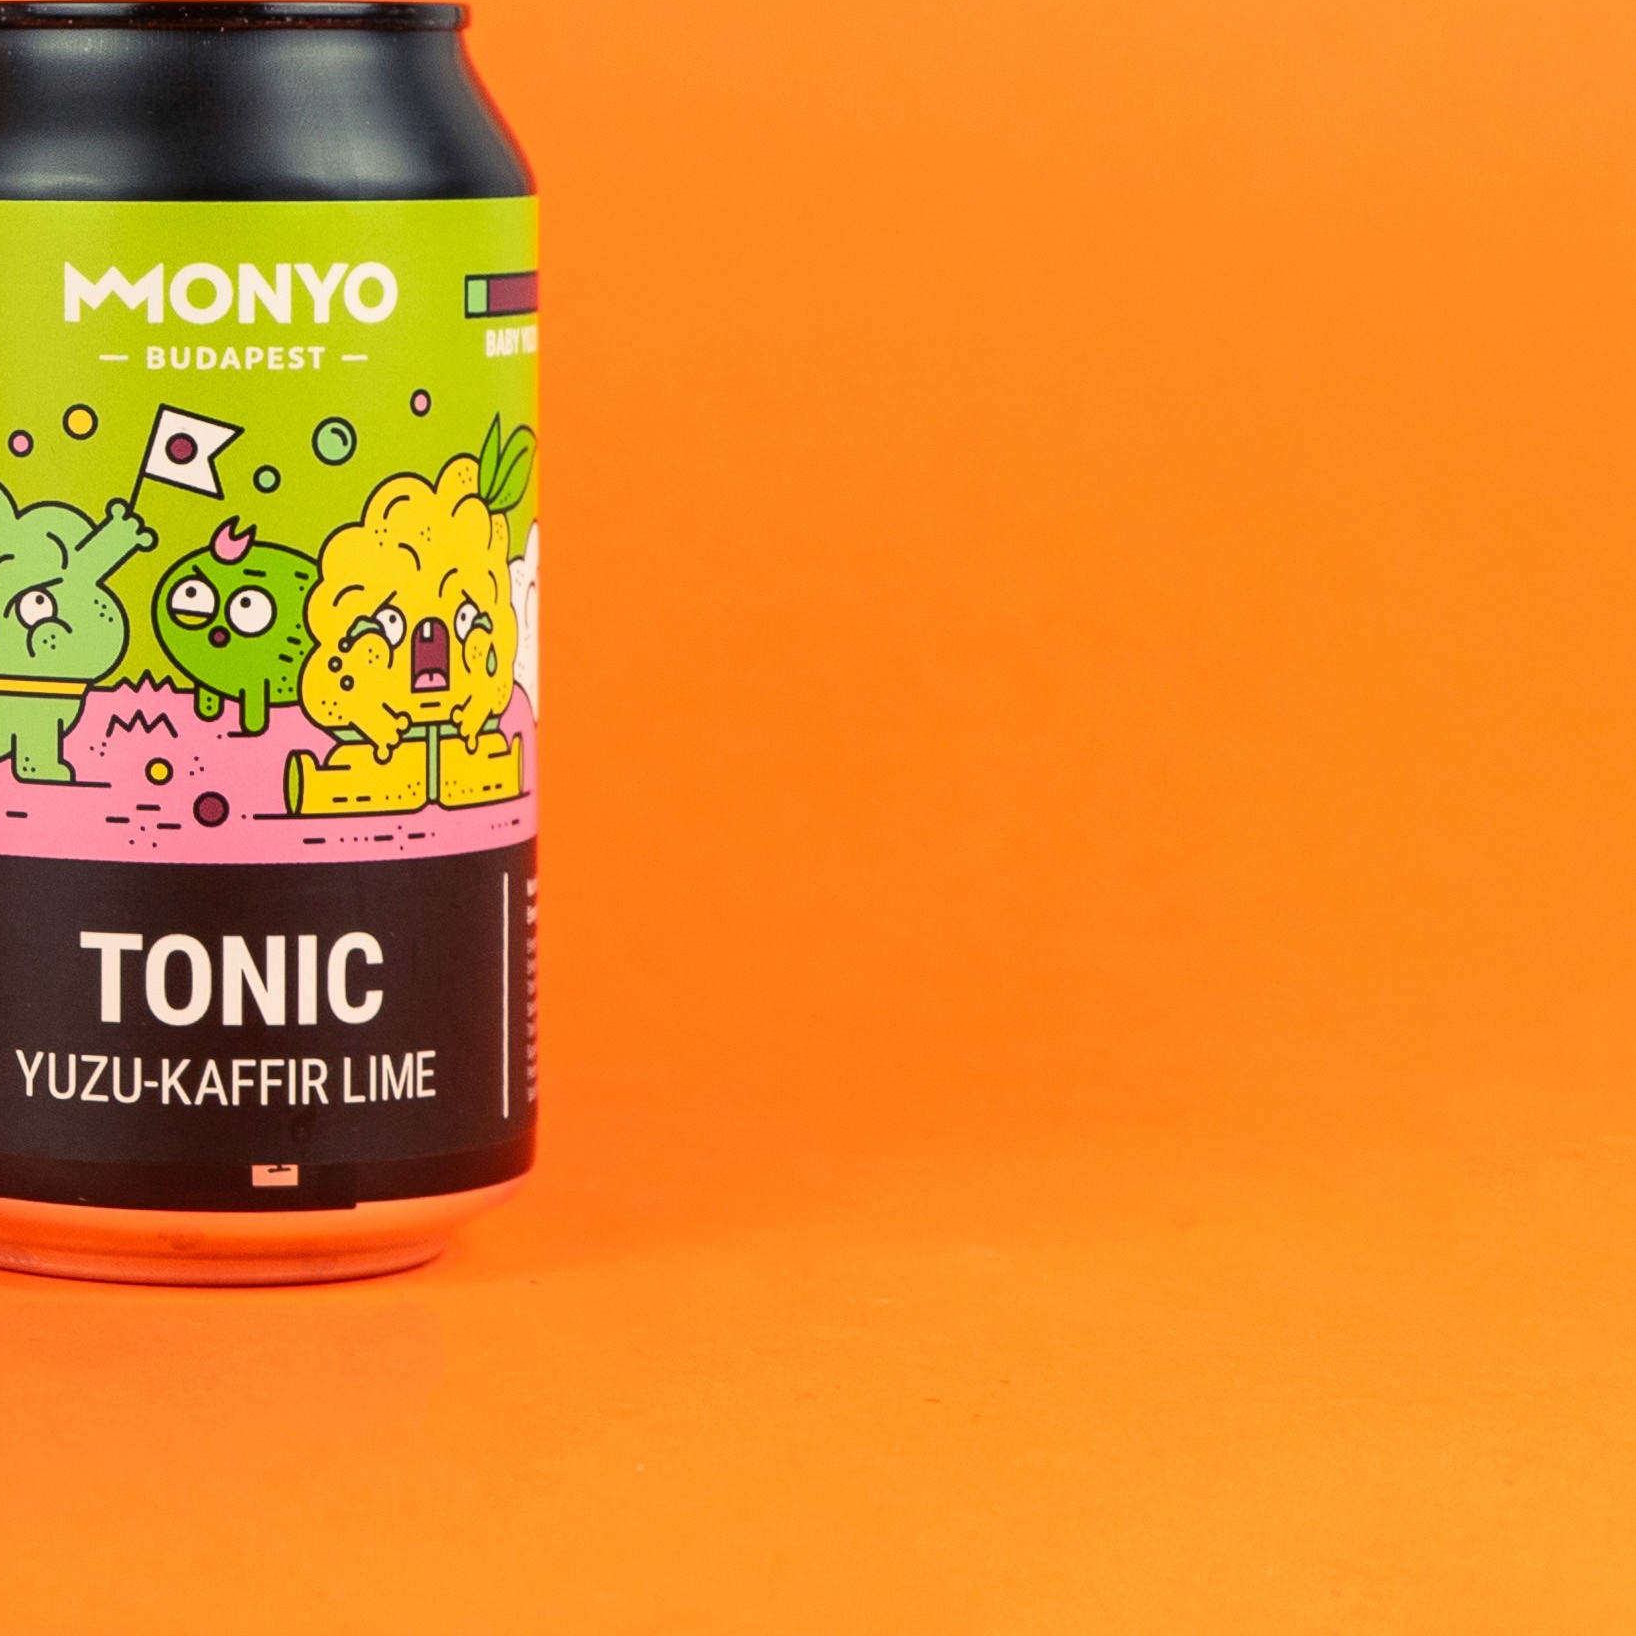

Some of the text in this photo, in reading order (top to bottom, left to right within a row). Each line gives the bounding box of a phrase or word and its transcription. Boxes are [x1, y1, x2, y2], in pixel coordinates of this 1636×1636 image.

[64, 262, 398, 325] MONYO
[147, 346, 324, 370] BUDAPEST
[486, 327, 520, 359] BABY
[80, 931, 383, 1026] TONIC
[15, 1049, 436, 1106] YUZU-KAFFIR LIME
